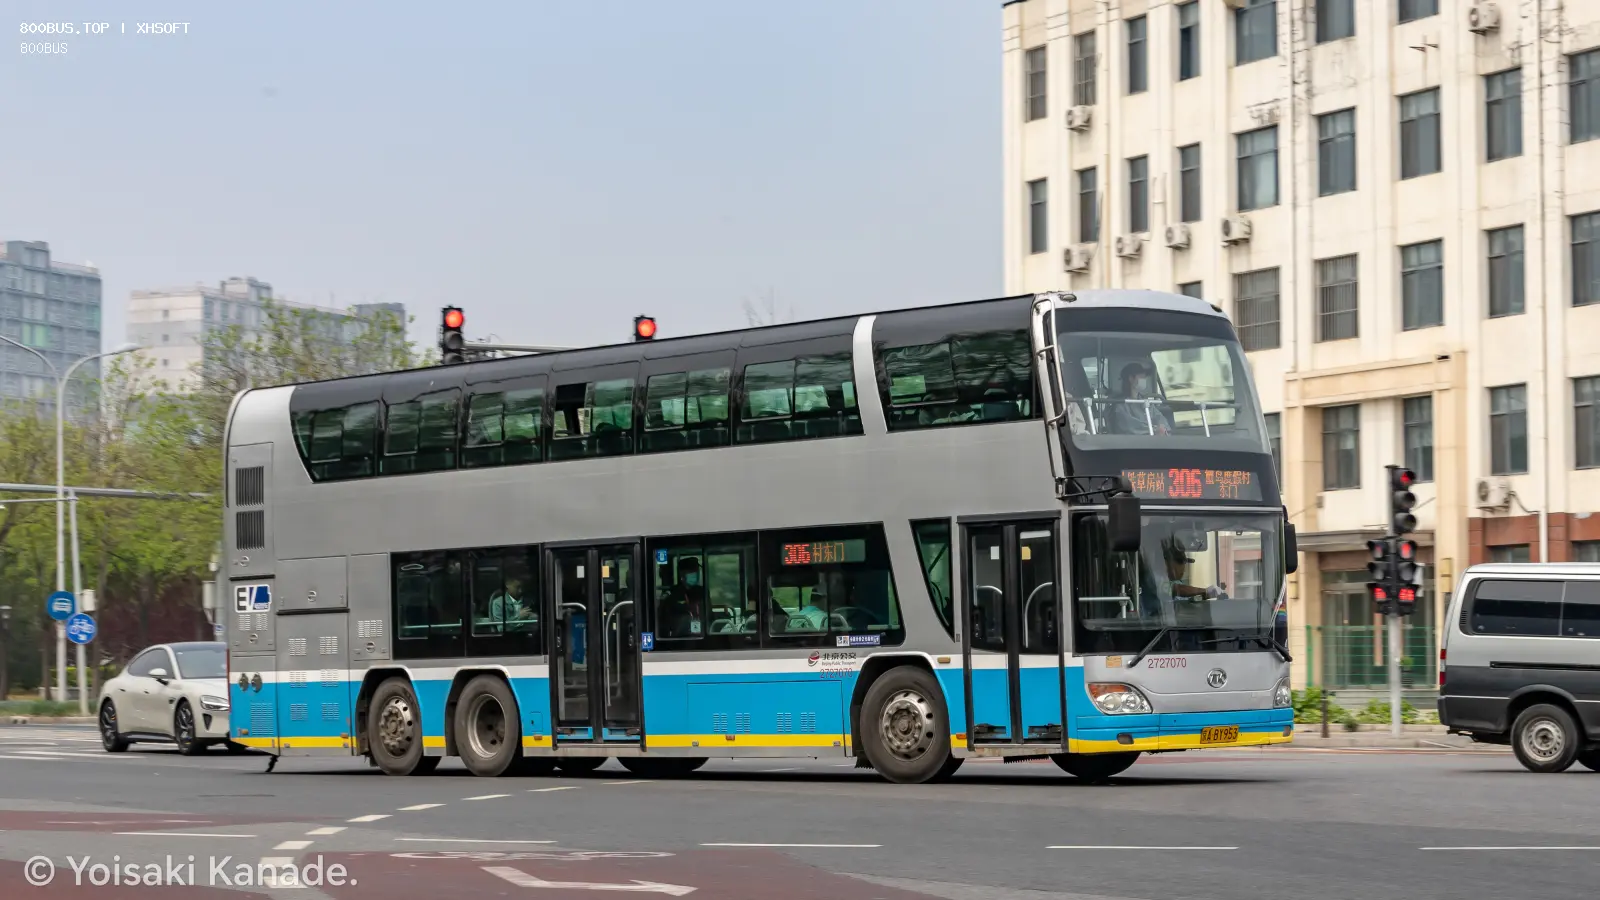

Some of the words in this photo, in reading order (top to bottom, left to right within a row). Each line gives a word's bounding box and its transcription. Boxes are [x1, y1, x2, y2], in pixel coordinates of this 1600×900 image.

[1121, 471, 1165, 493] 铁草房站
[1168, 468, 1202, 498] 306
[1219, 484, 1238, 499] 东门
[784, 543, 811, 565] 306
[812, 542, 845, 563] 村东门
[822, 652, 857, 661] 北京公交
[1147, 657, 1187, 669] 2727070
[820, 667, 853, 679] 2727070
